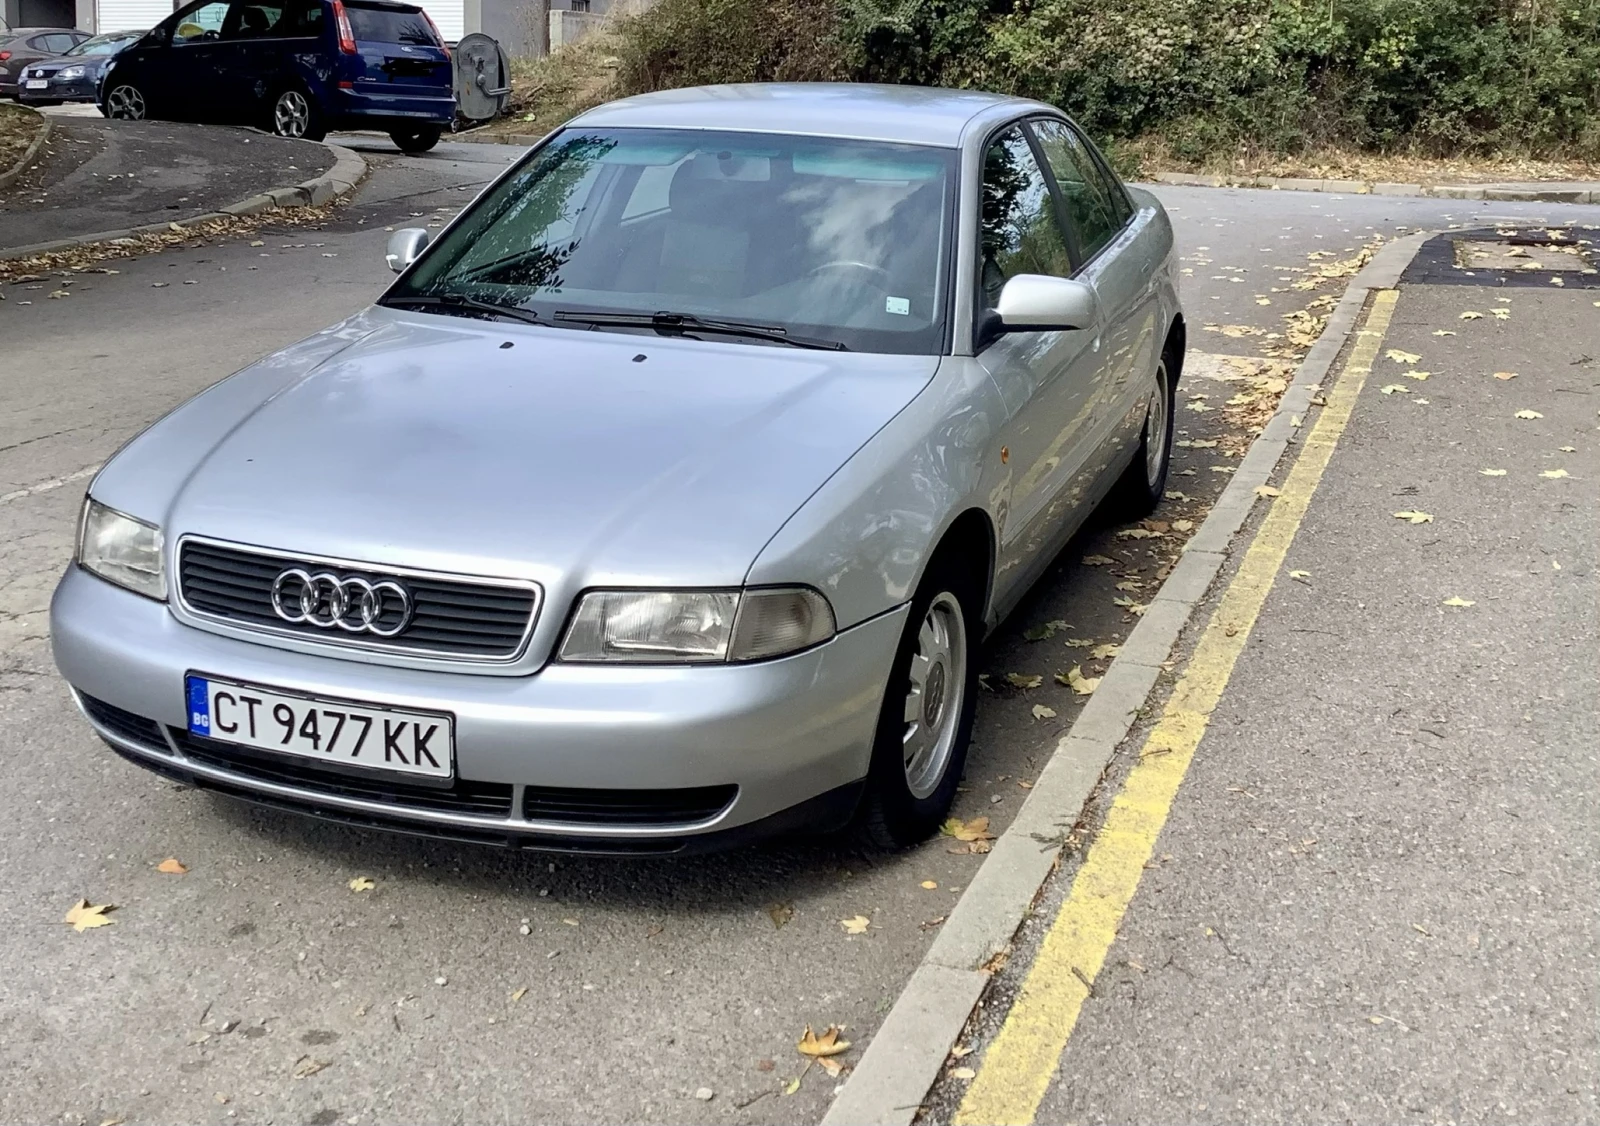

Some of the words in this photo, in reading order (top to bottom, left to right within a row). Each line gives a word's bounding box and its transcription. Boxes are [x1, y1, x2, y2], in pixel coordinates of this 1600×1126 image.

[193, 712, 209, 728] BG
[214, 691, 262, 739] CT
[273, 703, 373, 757] 9477
[384, 719, 441, 768] KK
